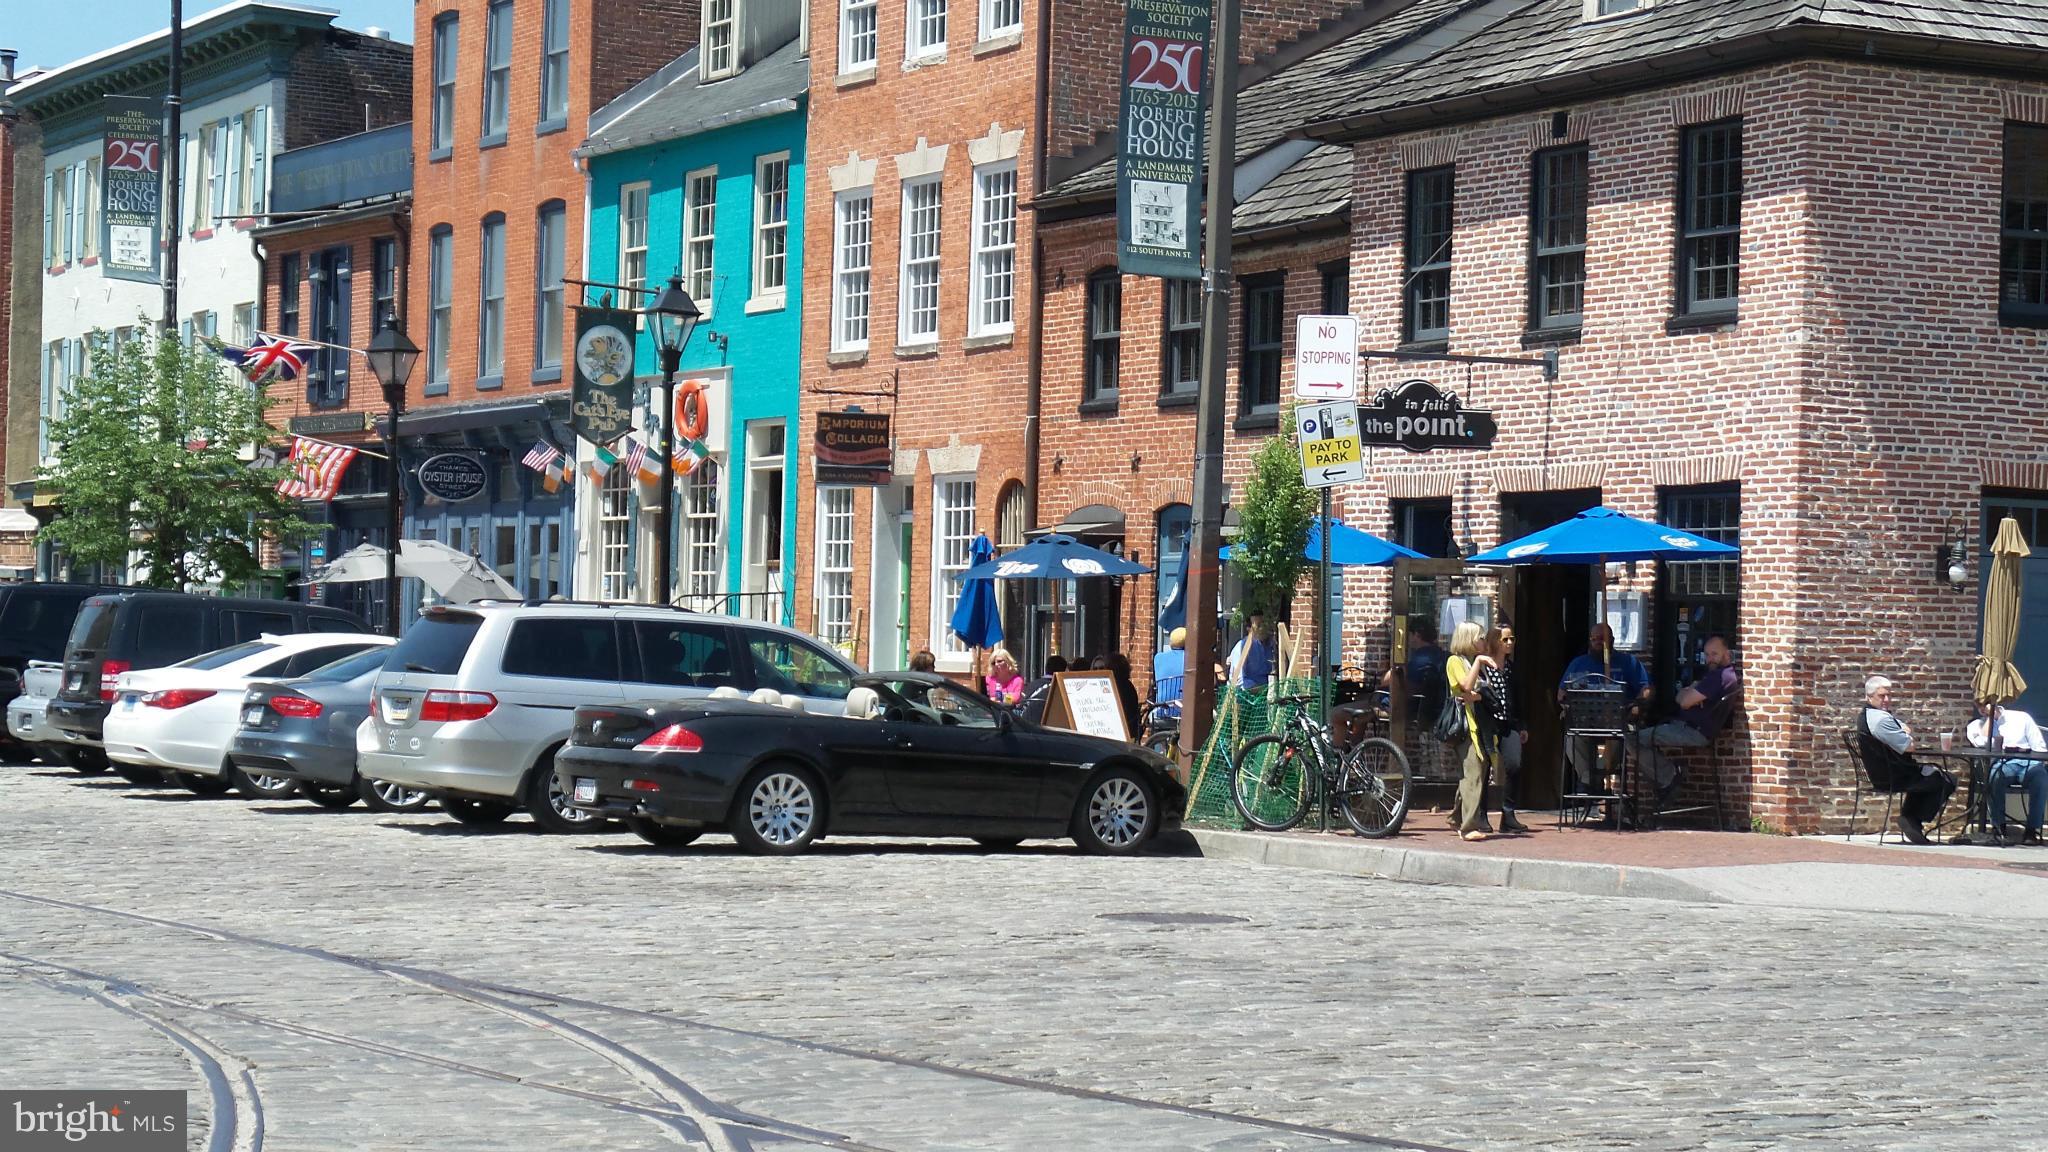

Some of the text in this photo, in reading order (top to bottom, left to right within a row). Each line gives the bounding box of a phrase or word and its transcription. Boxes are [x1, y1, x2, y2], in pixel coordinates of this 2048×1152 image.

[1130, 0, 1209, 17] PRESERVATION
[1147, 12, 1194, 27] SOCIETY
[1131, 25, 1203, 42] CELEBRATING
[1129, 40, 1203, 95] 250
[1129, 89, 1198, 109] 1765-2015
[106, 116, 161, 126] PRESERVATION
[1127, 104, 1197, 124] ROBERT
[118, 123, 151, 132] SOCIETY
[1126, 117, 1196, 143] LONG
[107, 131, 159, 141] CELEBRATING
[1126, 137, 1195, 160] HOUSE
[108, 140, 159, 173] 250
[1125, 159, 1194, 174] A LANDMARK
[108, 170, 157, 182] 1765-2015
[1125, 169, 1194, 183] ANNIVERSARY
[108, 179, 156, 191] ROBERT
[108, 187, 156, 203] LONG
[107, 199, 157, 213] HOUSE
[106, 219, 156, 227] ANNIVERSARY
[115, 213, 156, 221] LANDMARK
[1126, 245, 1138, 253] 812
[1139, 246, 1164, 256] SOUTH
[1165, 250, 1181, 258] ANN
[1318, 326, 1337, 339] NO
[1302, 350, 1351, 365] STOPPING
[588, 389, 617, 405] The
[1405, 399, 1418, 410] in
[587, 417, 616, 432] Pub
[1305, 422, 1313, 431] P
[1365, 418, 1394, 434] the
[1309, 439, 1352, 454] PAY TO
[1315, 451, 1349, 465] PARK
[439, 464, 469, 472] THAMES
[423, 471, 483, 484] OYSTER HOUSE
